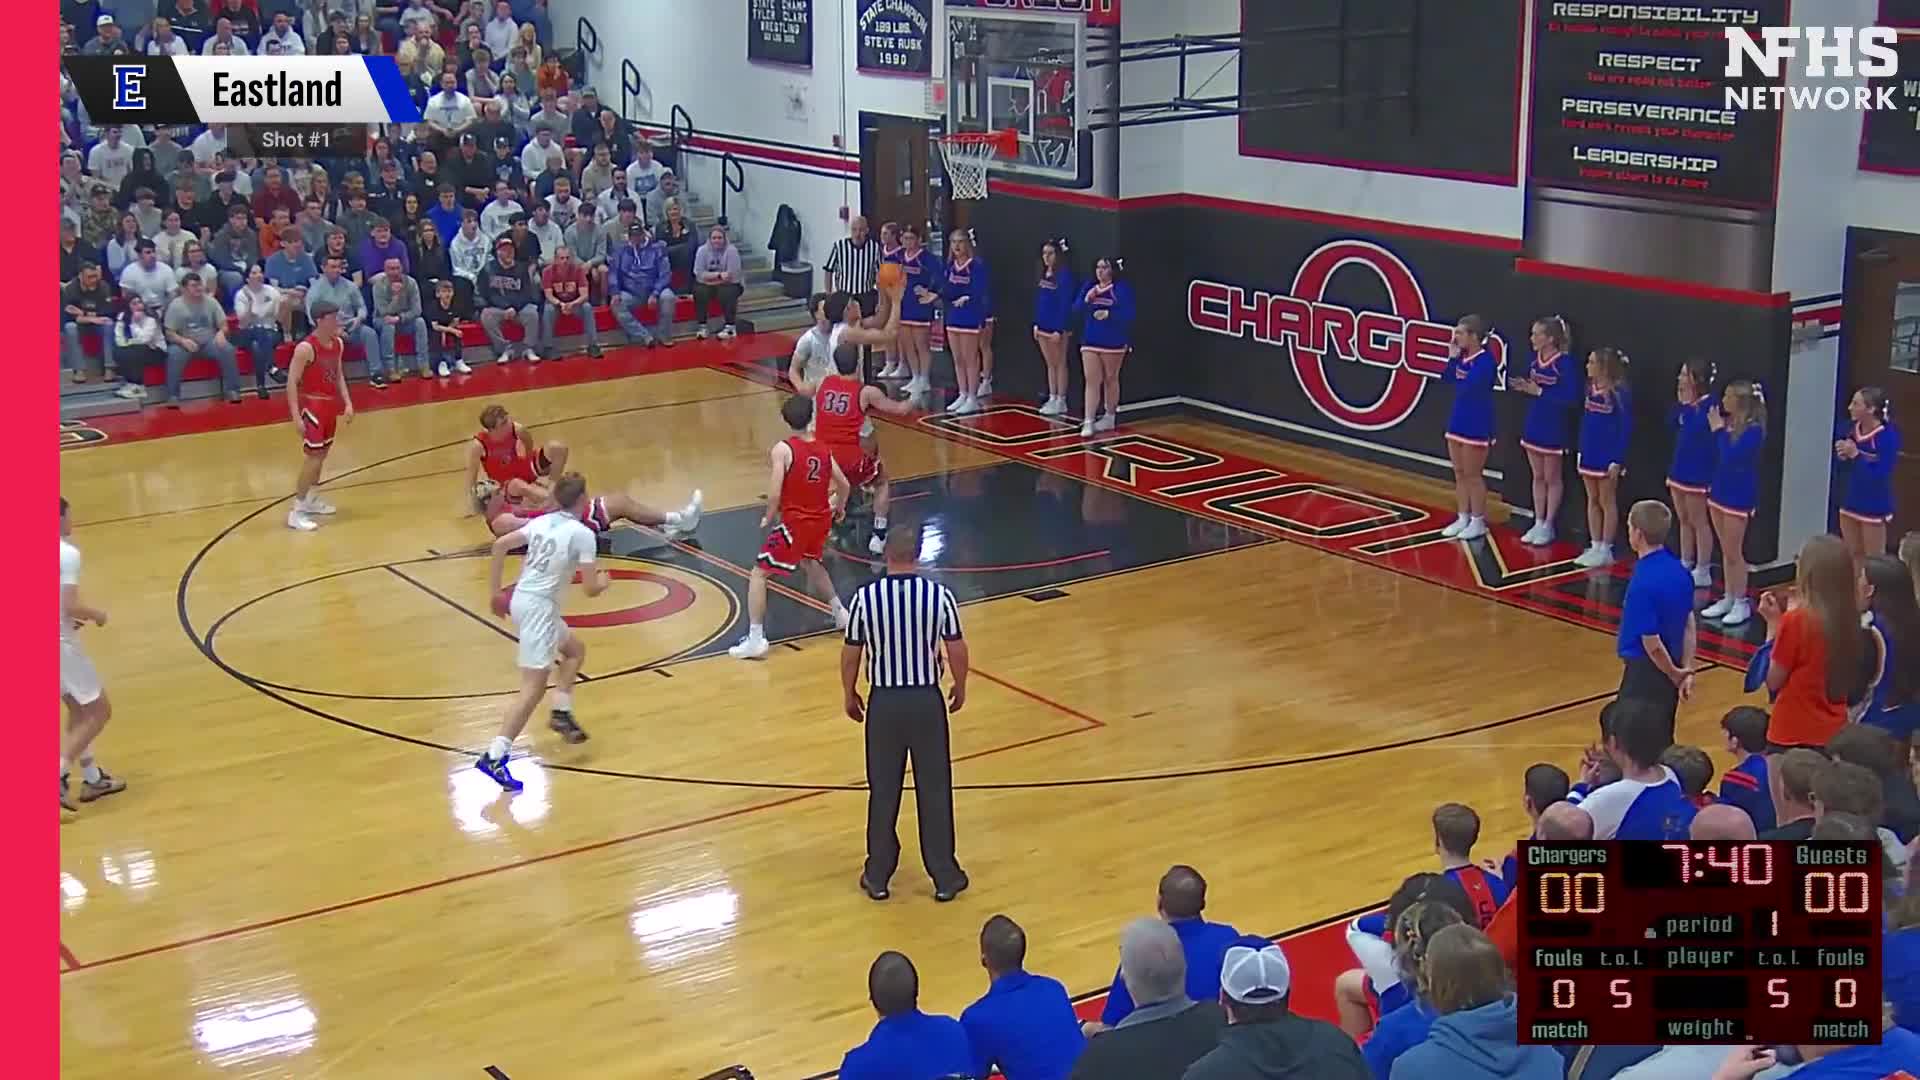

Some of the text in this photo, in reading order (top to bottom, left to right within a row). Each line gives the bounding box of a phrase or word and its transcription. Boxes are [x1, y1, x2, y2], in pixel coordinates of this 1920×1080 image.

[752, 8, 808, 24] TYLER CLARK
[860, 0, 929, 35] STATE CHAMPION
[1553, 3, 1759, 24] RESPONSIBILITY
[760, 20, 800, 35] WRESTLING
[864, 35, 922, 51] STEVE RUSK
[879, 52, 907, 65] 1990
[1598, 52, 1701, 72] RESPECT
[1562, 98, 1737, 126] PERSEVERANCE
[1573, 146, 1718, 172] LEADERSHIP
[1188, 280, 1507, 391] CHARGE
[824, 390, 850, 416] 35
[807, 455, 821, 483] 2
